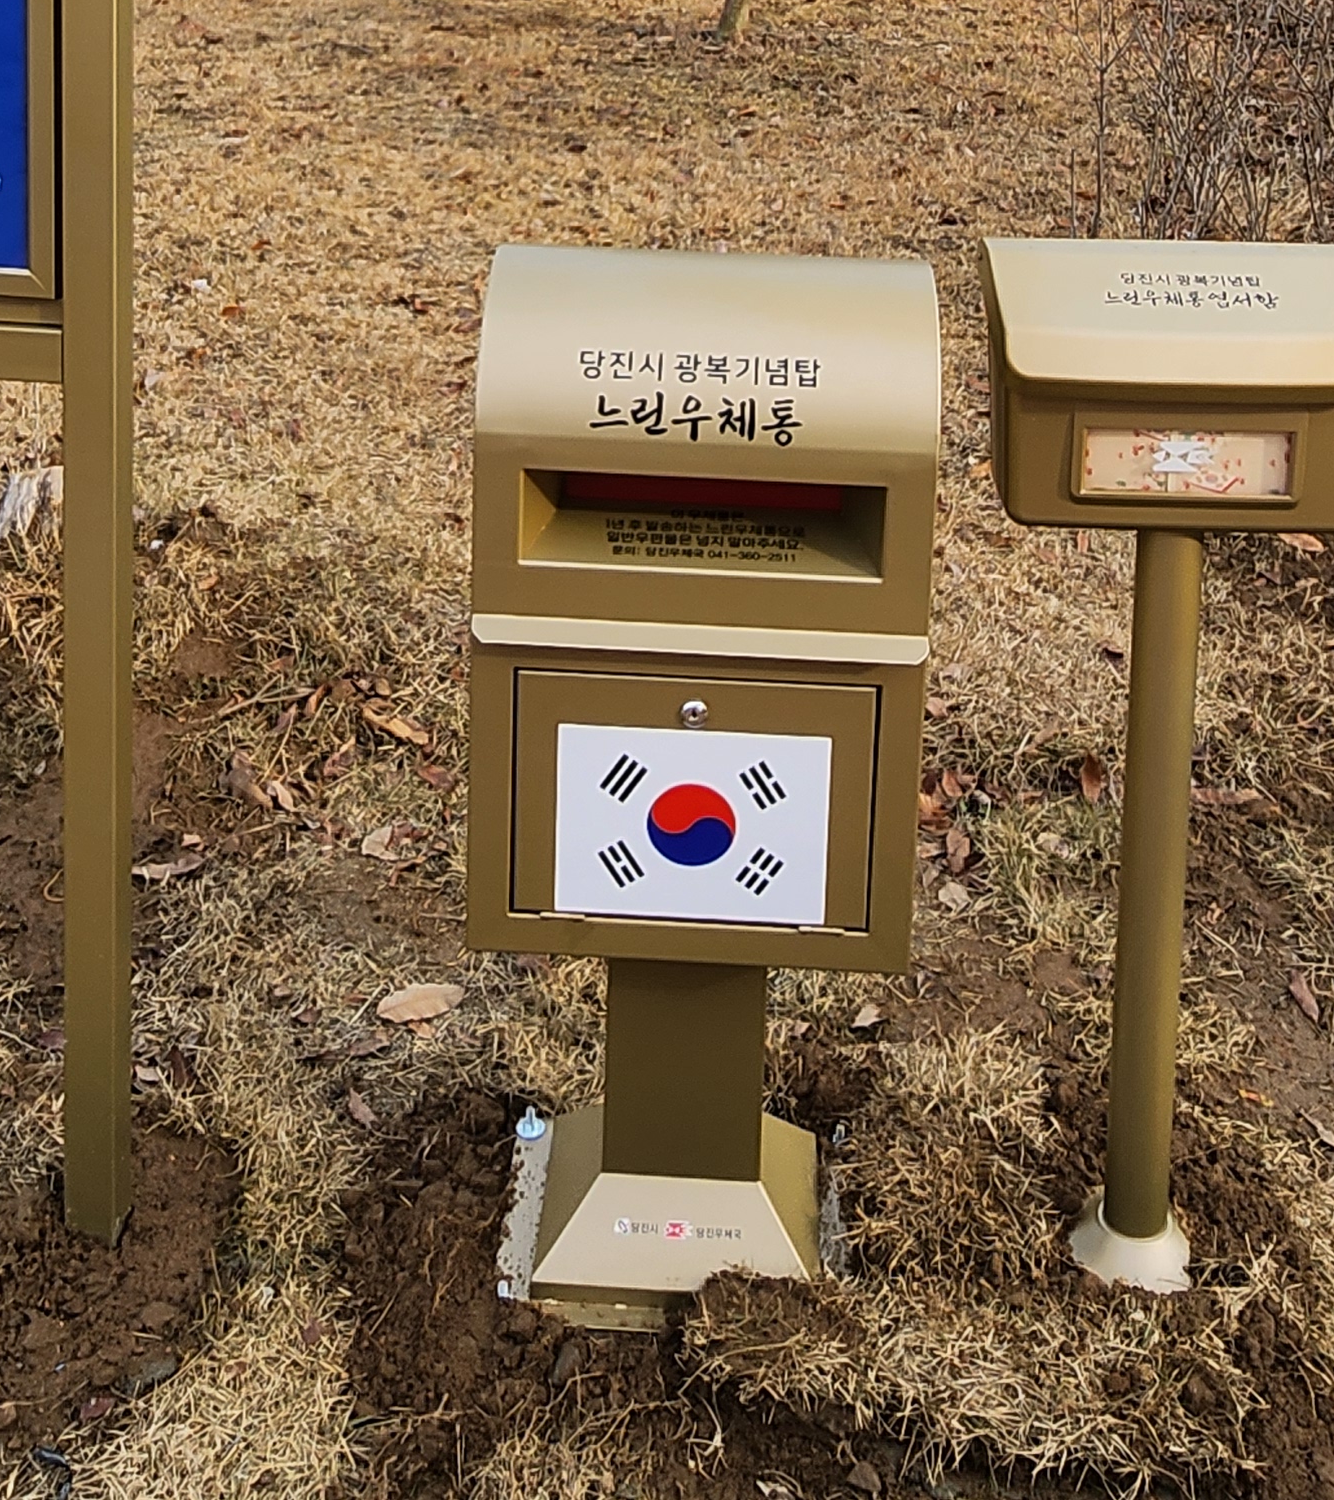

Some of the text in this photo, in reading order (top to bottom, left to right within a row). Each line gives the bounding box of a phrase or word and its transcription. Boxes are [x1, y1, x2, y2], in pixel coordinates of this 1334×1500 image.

[1121, 273, 1260, 287] 당진시 광복기념탑
[579, 350, 821, 388] 당진시 광복기념탑
[590, 391, 803, 447] 느린우체통
[708, 550, 797, 563] 041-360-2511
[631, 1222, 742, 1240] 당진시 당진우체국
